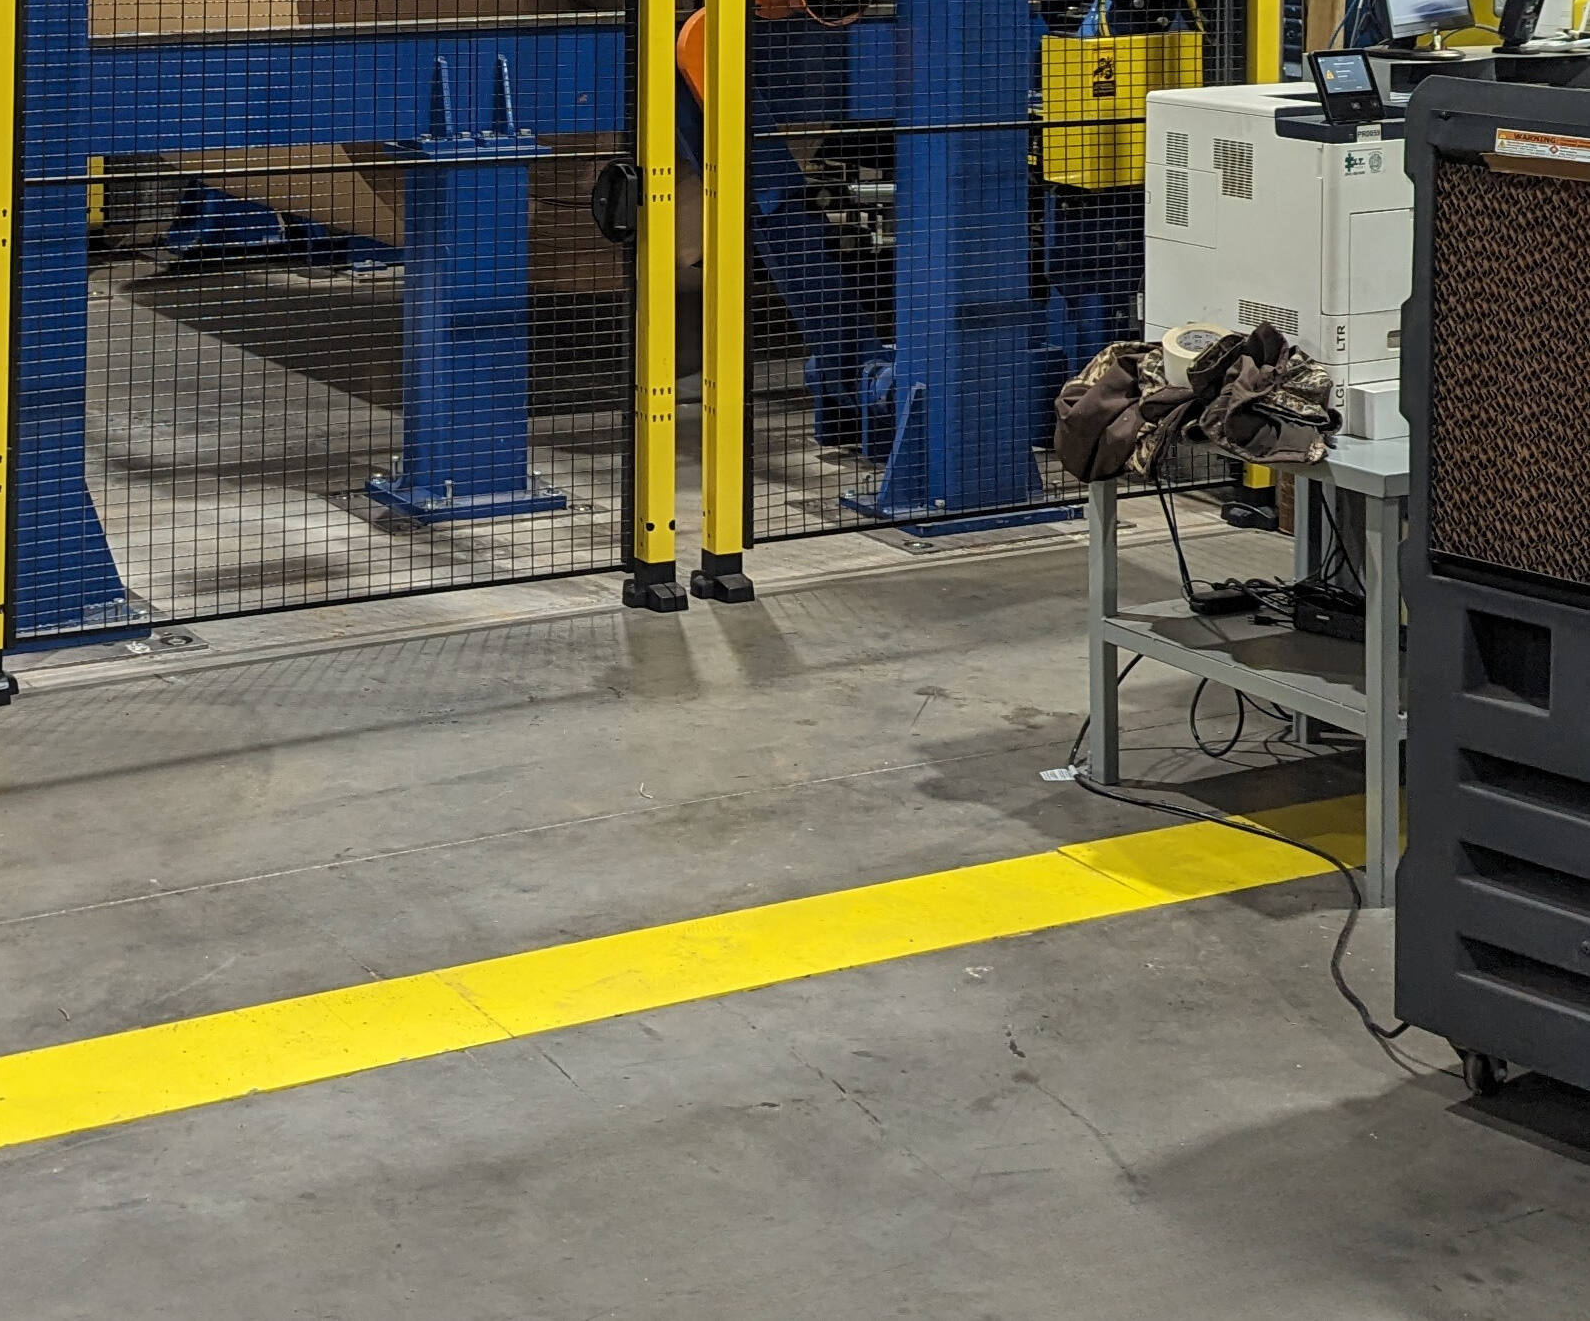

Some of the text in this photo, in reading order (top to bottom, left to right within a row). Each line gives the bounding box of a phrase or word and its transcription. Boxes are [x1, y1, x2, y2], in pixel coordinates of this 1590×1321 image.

[1513, 132, 1556, 144] WARNING
[1336, 325, 1346, 352] LTR
[1335, 378, 1345, 407] LGL
